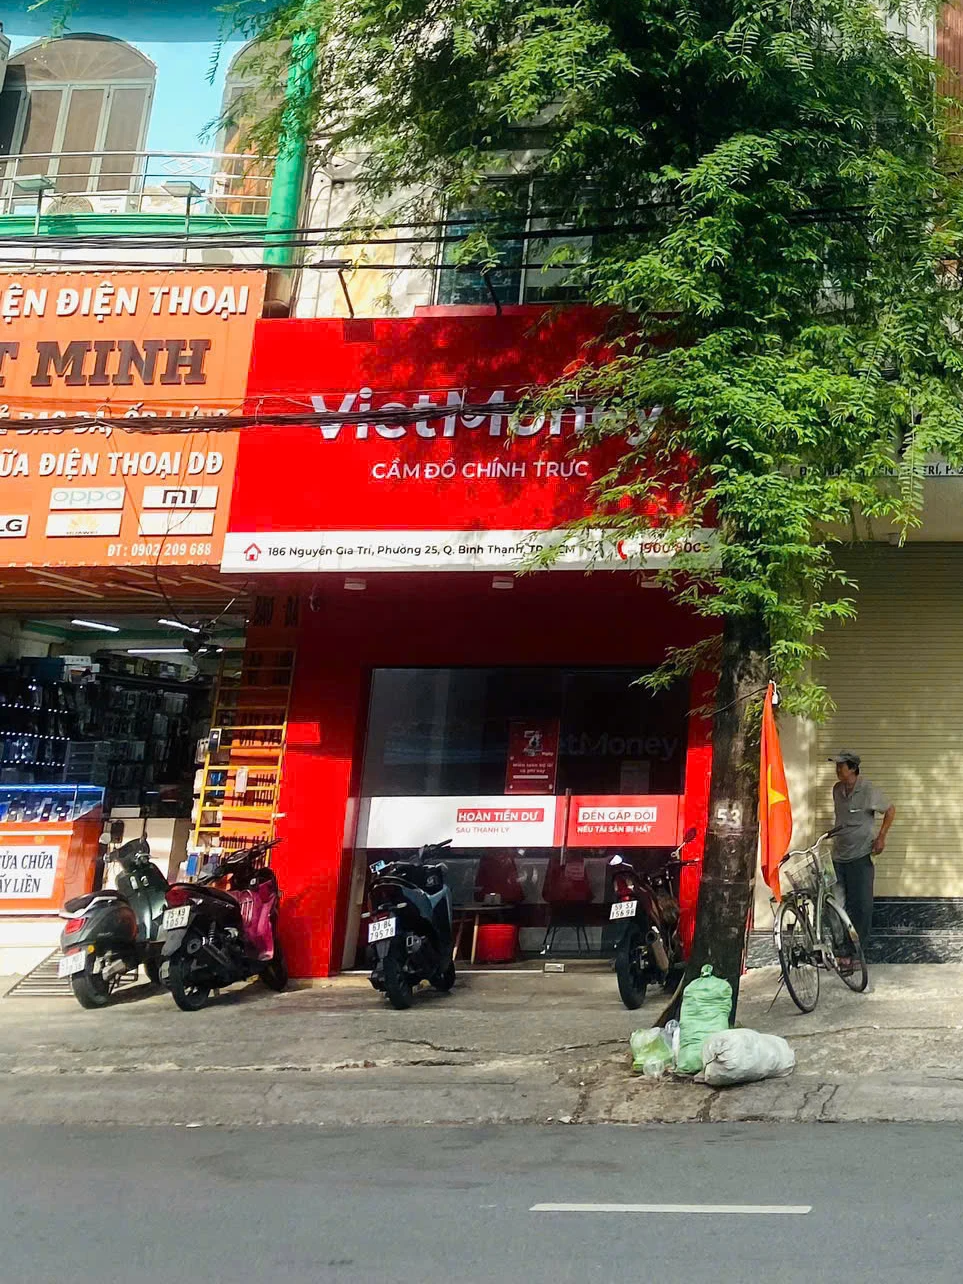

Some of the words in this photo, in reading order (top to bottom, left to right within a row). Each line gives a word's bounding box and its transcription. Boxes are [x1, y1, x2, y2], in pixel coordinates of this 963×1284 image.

[55, 280, 140, 323] ĐIỆN
[149, 285, 250, 320] THOẠI
[30, 339, 212, 387] MINH
[39, 447, 100, 481] ĐIỆN
[107, 451, 182, 480] THOẠI
[187, 451, 224, 476] DĐ
[371, 457, 421, 479] CẦM
[424, 457, 457, 480] ĐỒ
[462, 460, 527, 479] CHÍNH
[533, 460, 590, 480] TRỰC
[53, 490, 121, 505] oppo
[0, 518, 23, 533] G
[131, 543, 161, 557] 0902
[164, 543, 187, 557] 209
[189, 542, 212, 556] 688
[268, 547, 286, 556] 186
[335, 546, 354, 556] Gia
[424, 545, 441, 556] 25,
[443, 545, 455, 556] Q.
[550, 544, 575, 554] CM
[458, 809, 491, 821] HOÀN
[521, 811, 538, 821] DƯ
[716, 808, 741, 826] 53
[456, 826, 471, 834] SAU
[0, 850, 18, 870] ỬA
[21, 851, 53, 870] CHỮA
